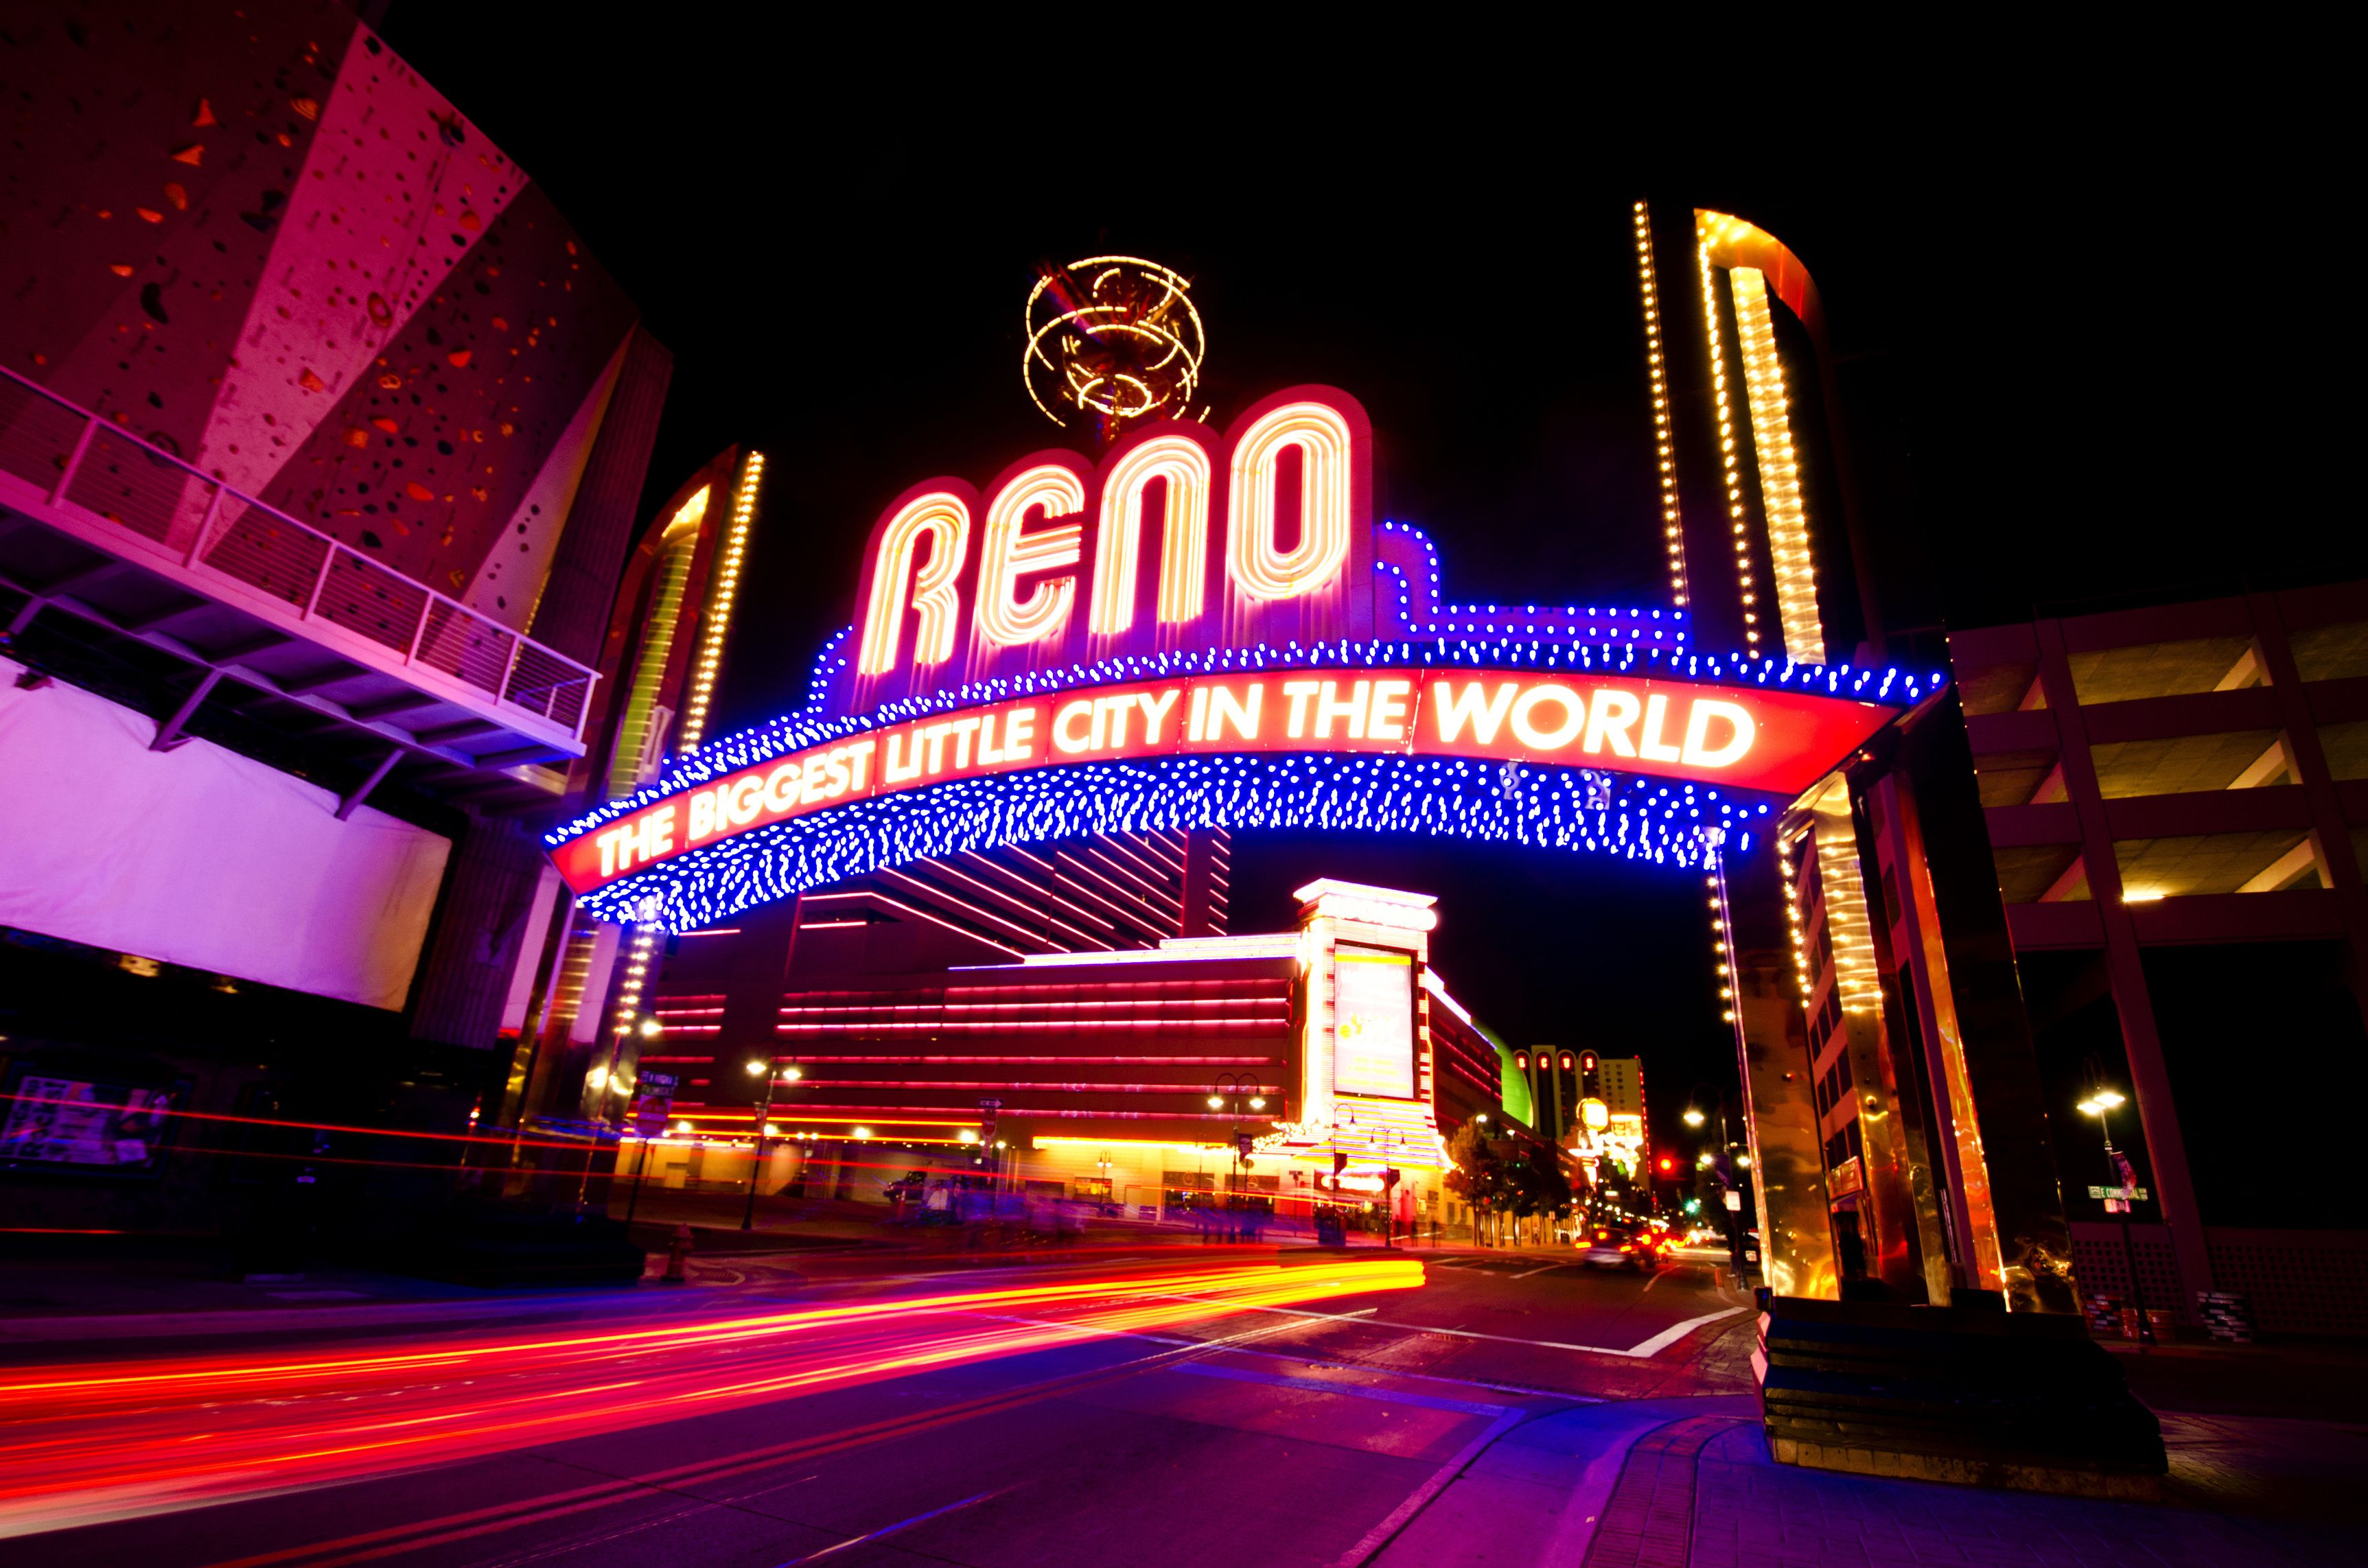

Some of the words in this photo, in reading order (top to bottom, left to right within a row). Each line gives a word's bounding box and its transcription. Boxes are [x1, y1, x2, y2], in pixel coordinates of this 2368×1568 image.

[859, 401, 1352, 675] RENO
[595, 805, 676, 878] THE
[687, 740, 878, 848] BIGGEST
[883, 707, 1036, 785] LITTLE
[1052, 689, 1181, 754] CITY
[1187, 682, 1264, 742] IN
[1281, 680, 1411, 740] THE
[1432, 680, 1757, 769] WORLD
[2106, 1188, 2140, 1200] COMMIAL
